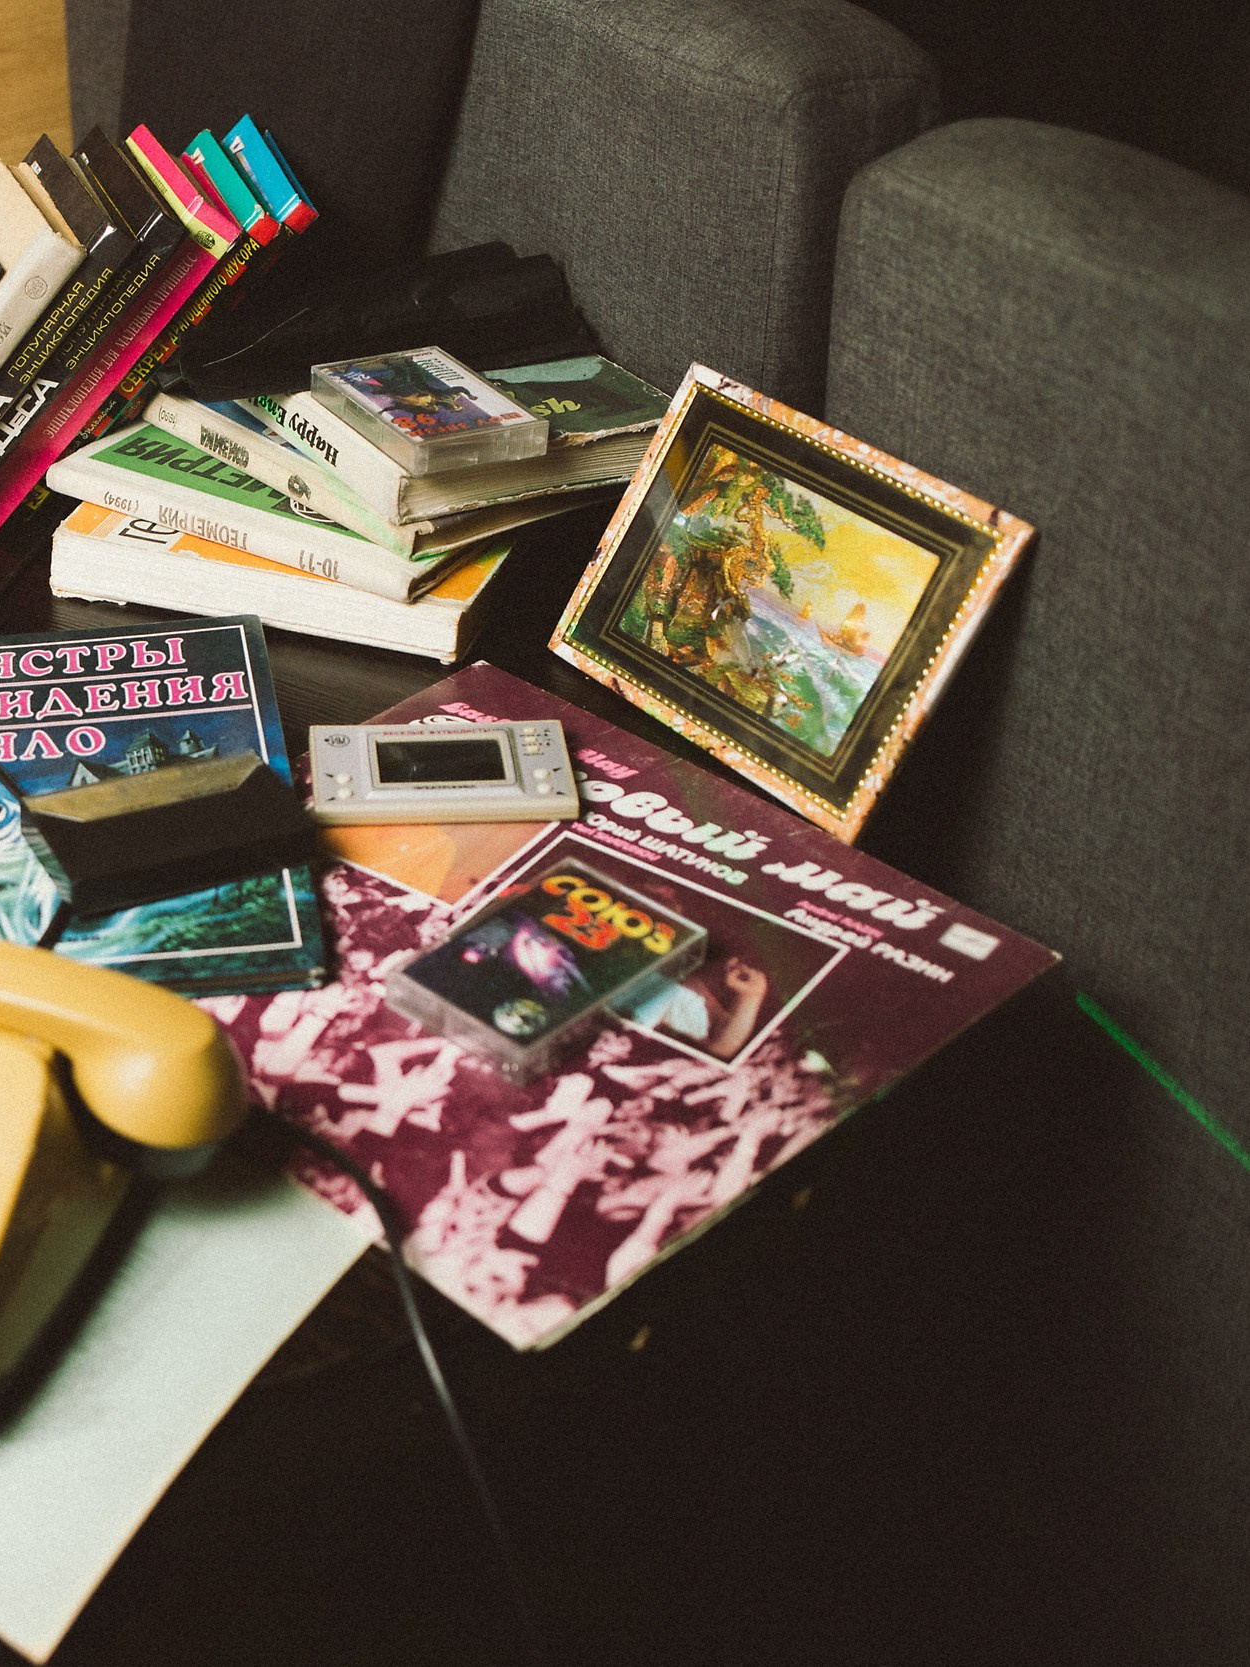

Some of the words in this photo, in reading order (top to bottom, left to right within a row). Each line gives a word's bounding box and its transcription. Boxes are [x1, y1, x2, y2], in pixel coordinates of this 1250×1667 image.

[7, 281, 84, 378] ПОПУЛЯРНАЯ
[19, 267, 112, 384] ЭНЦИКЛОПЕДИЯ
[65, 254, 160, 370] ЭНЦИКЛОПЕДИЯ
[119, 341, 171, 393] СЕКРЕТ
[225, 237, 260, 280] МУСОРА
[43, 367, 106, 439] ЭНЦИКЛОПЕДИЯ
[105, 348, 120, 371] ДЛЯ
[116, 301, 162, 354] МАЛЕНЬКИХ
[155, 255, 199, 304] ПРИНЦЕСС
[114, 436, 293, 500] МЕТРИЯ
[200, 424, 250, 469] ФИЗИКА
[289, 412, 339, 468] Happy
[104, 491, 139, 514] (1994)
[158, 504, 248, 550] ГЕОМЕТРИЯ
[299, 549, 341, 580] 10-11
[639, 835, 749, 886] ШАТУНОВ
[541, 875, 676, 955] СОЮЗ
[543, 899, 622, 950] 23
[760, 861, 947, 930] май
[870, 942, 956, 983] РАЗИН
